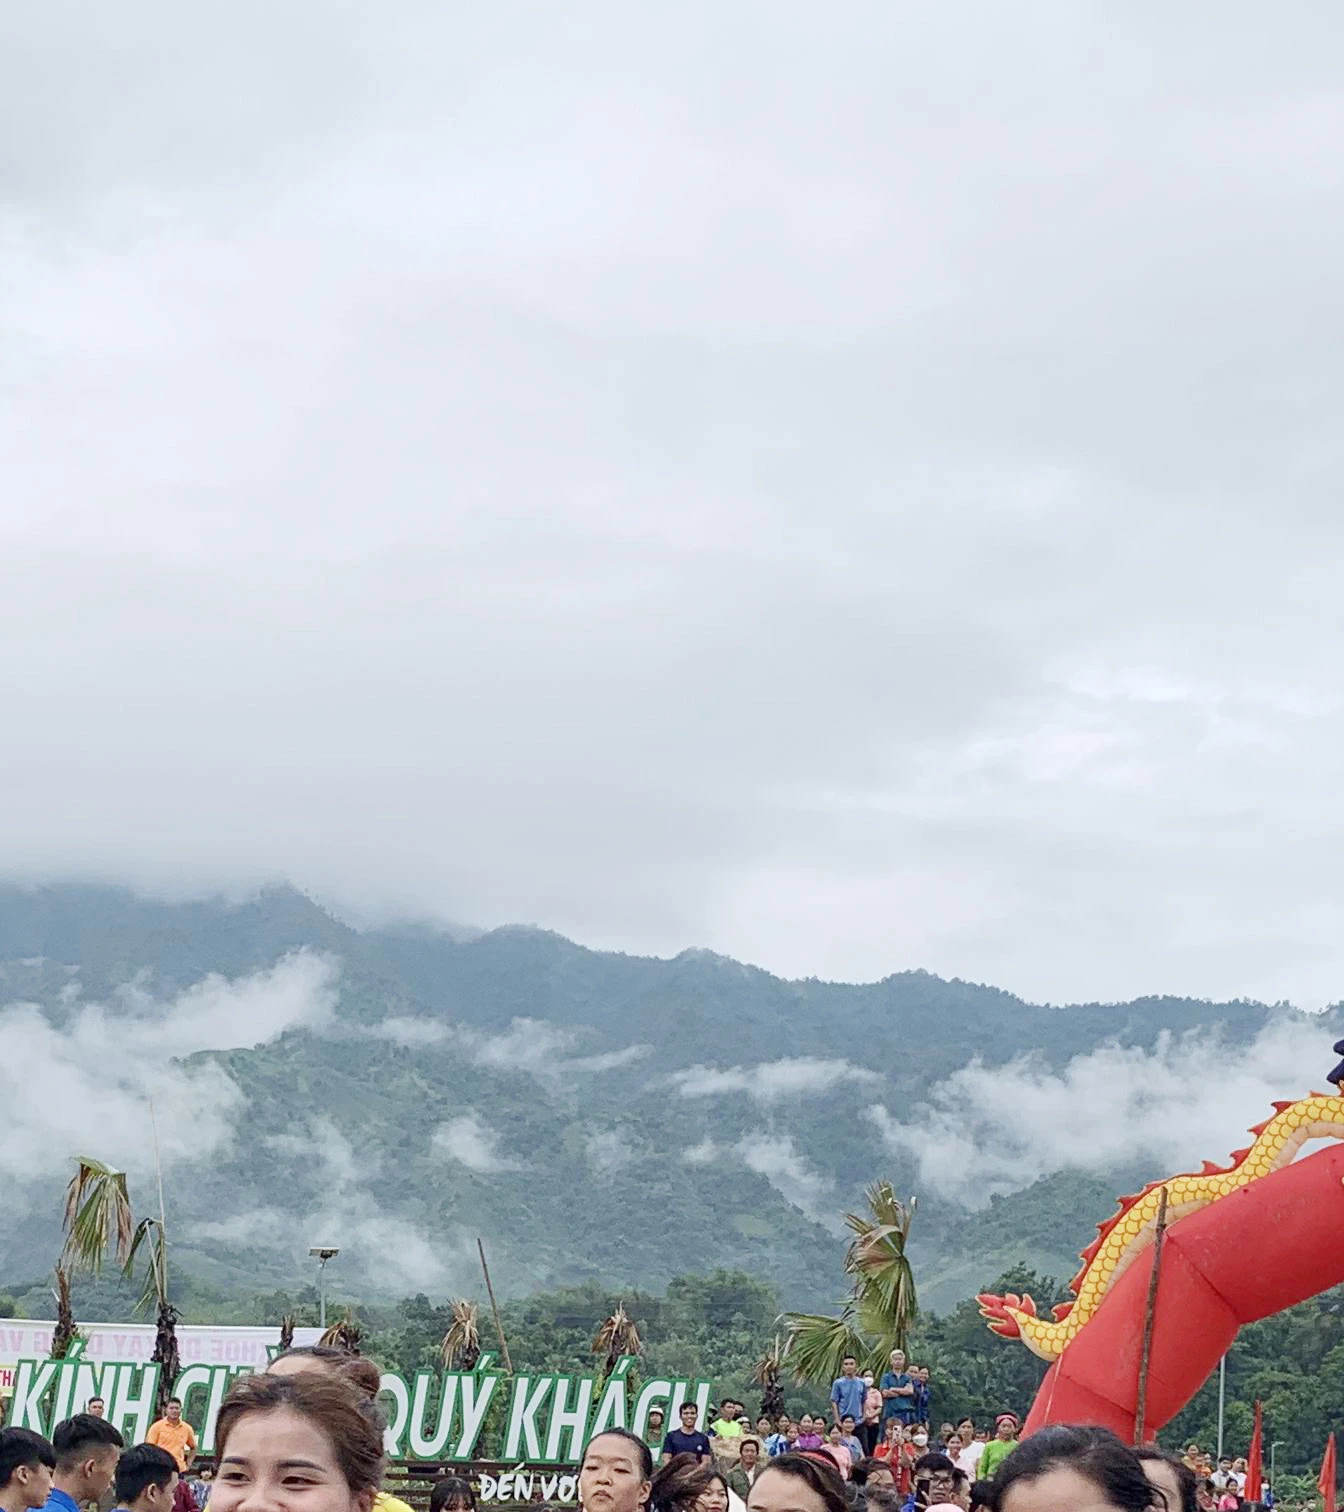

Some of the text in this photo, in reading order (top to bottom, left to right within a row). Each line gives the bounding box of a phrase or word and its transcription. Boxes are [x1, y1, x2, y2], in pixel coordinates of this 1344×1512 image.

[6, 1338, 161, 1452] KÍNH
[378, 1351, 499, 1460] QUÝ
[478, 1462, 534, 1501] ĐẾN
